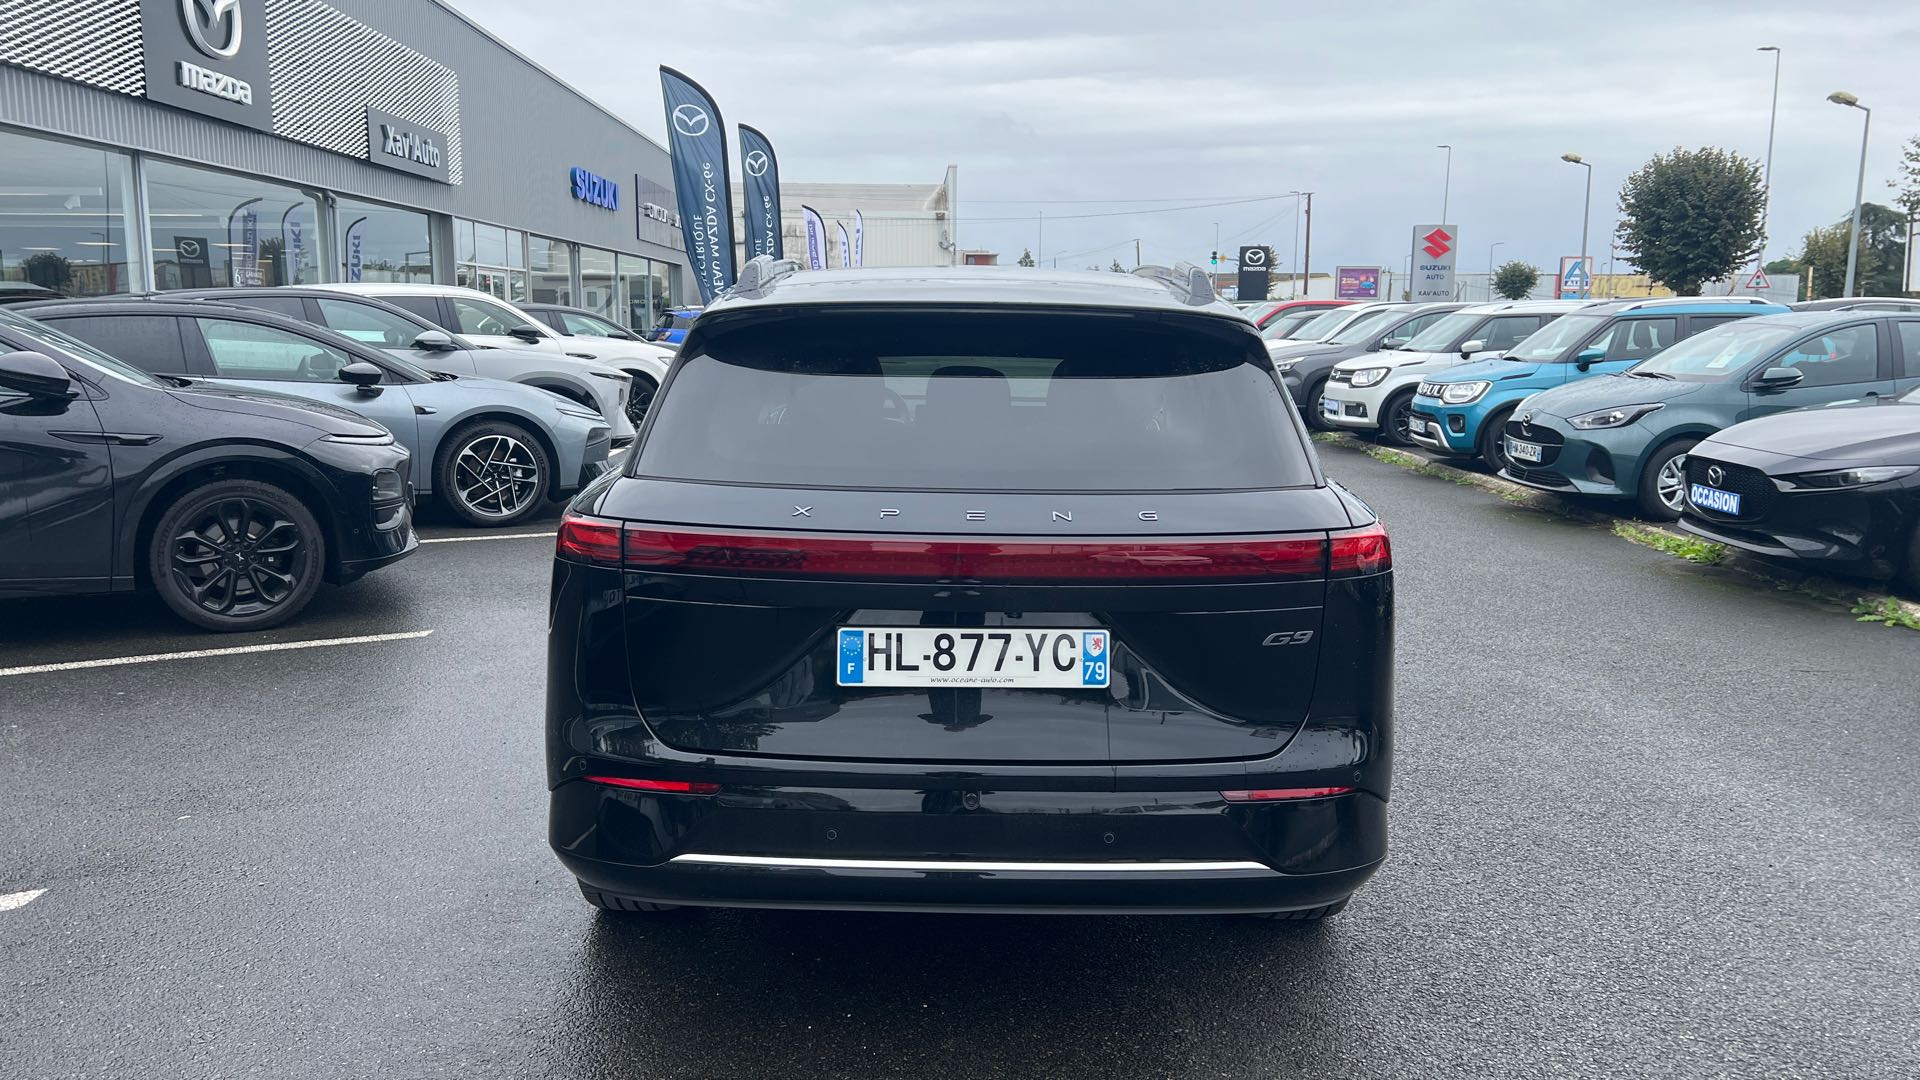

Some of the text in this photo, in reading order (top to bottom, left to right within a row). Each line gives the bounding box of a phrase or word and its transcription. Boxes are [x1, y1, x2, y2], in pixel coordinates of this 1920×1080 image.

[383, 124, 440, 168] Xav'Auto
[572, 167, 620, 211] SUZUKI
[1691, 485, 1738, 513] OCCASION
[1262, 630, 1314, 646] G9
[868, 633, 1076, 672] HL-877-YC
[847, 663, 855, 674] F
[1085, 661, 1105, 680] 79
